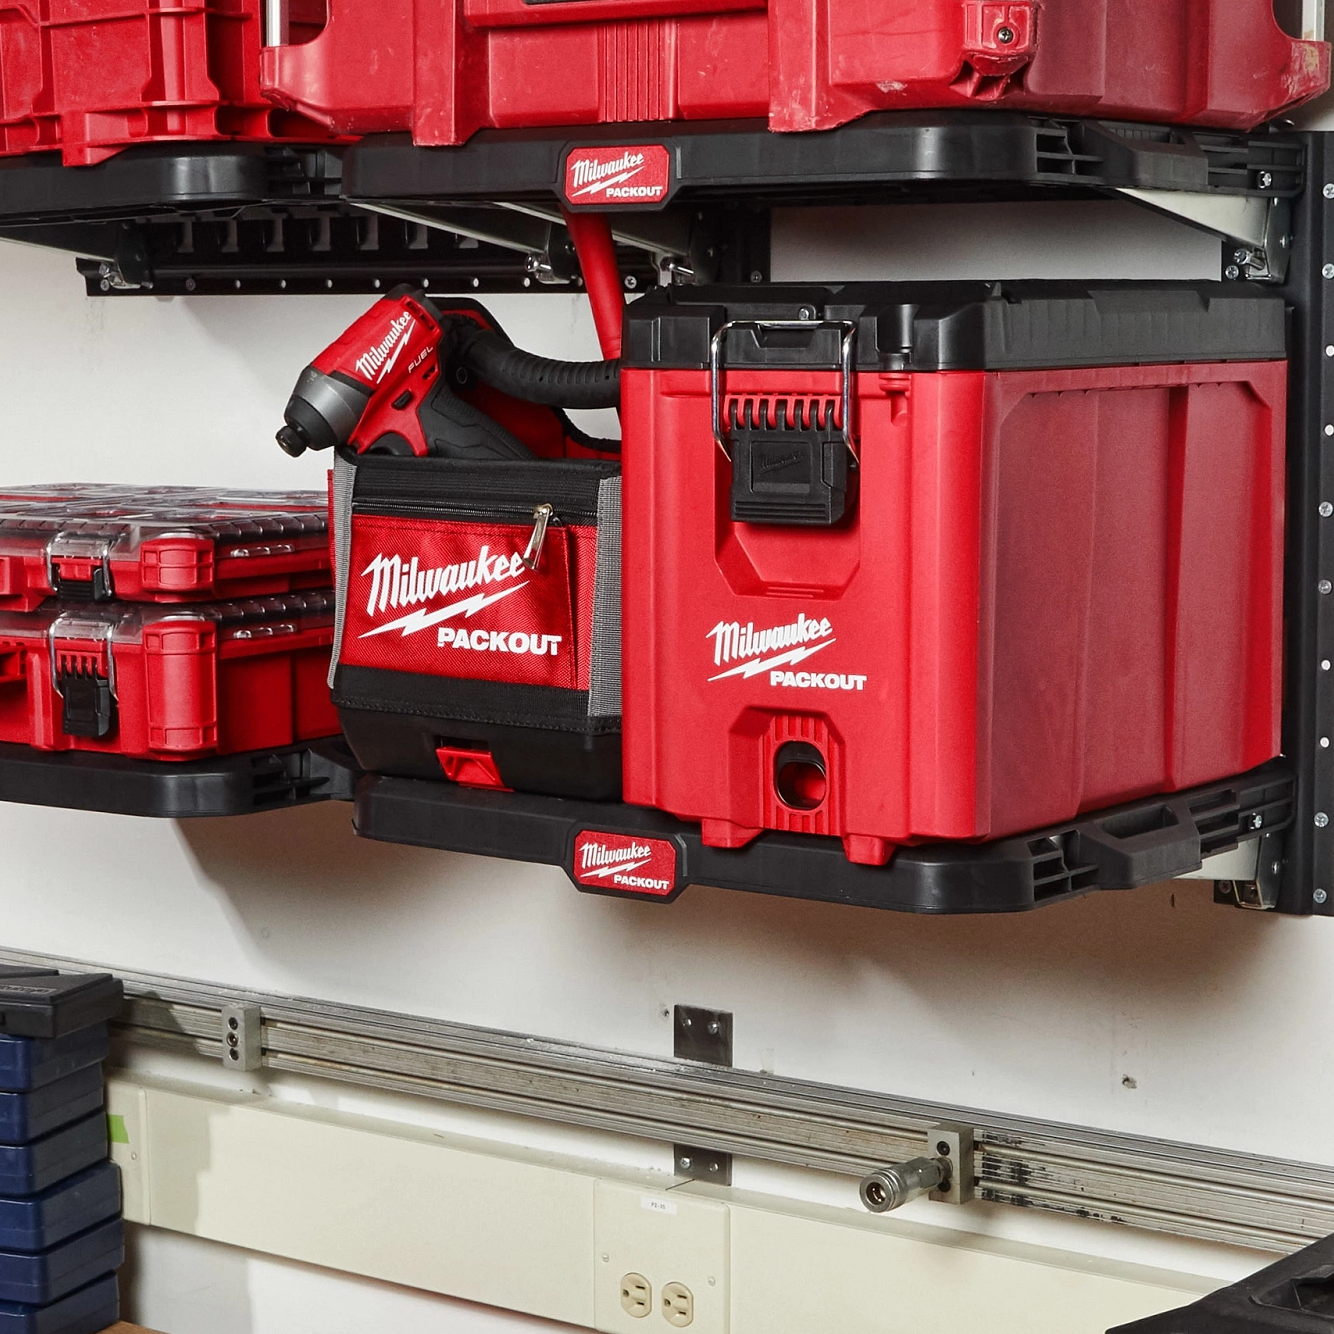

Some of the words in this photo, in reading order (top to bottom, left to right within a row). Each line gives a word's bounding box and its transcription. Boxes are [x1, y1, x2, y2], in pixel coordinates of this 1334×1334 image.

[571, 151, 645, 188] Milwaukee
[606, 186, 663, 198] PACKOUT
[355, 311, 412, 381] Milwaukee
[408, 346, 434, 374] FUEL
[361, 545, 526, 617] Milwaukee
[437, 627, 562, 656] PACKOUT
[705, 612, 834, 667] Milwaukee
[770, 671, 868, 691] PACKOUT
[579, 841, 652, 869] Milwaukee
[614, 874, 670, 890] PACKOUT
